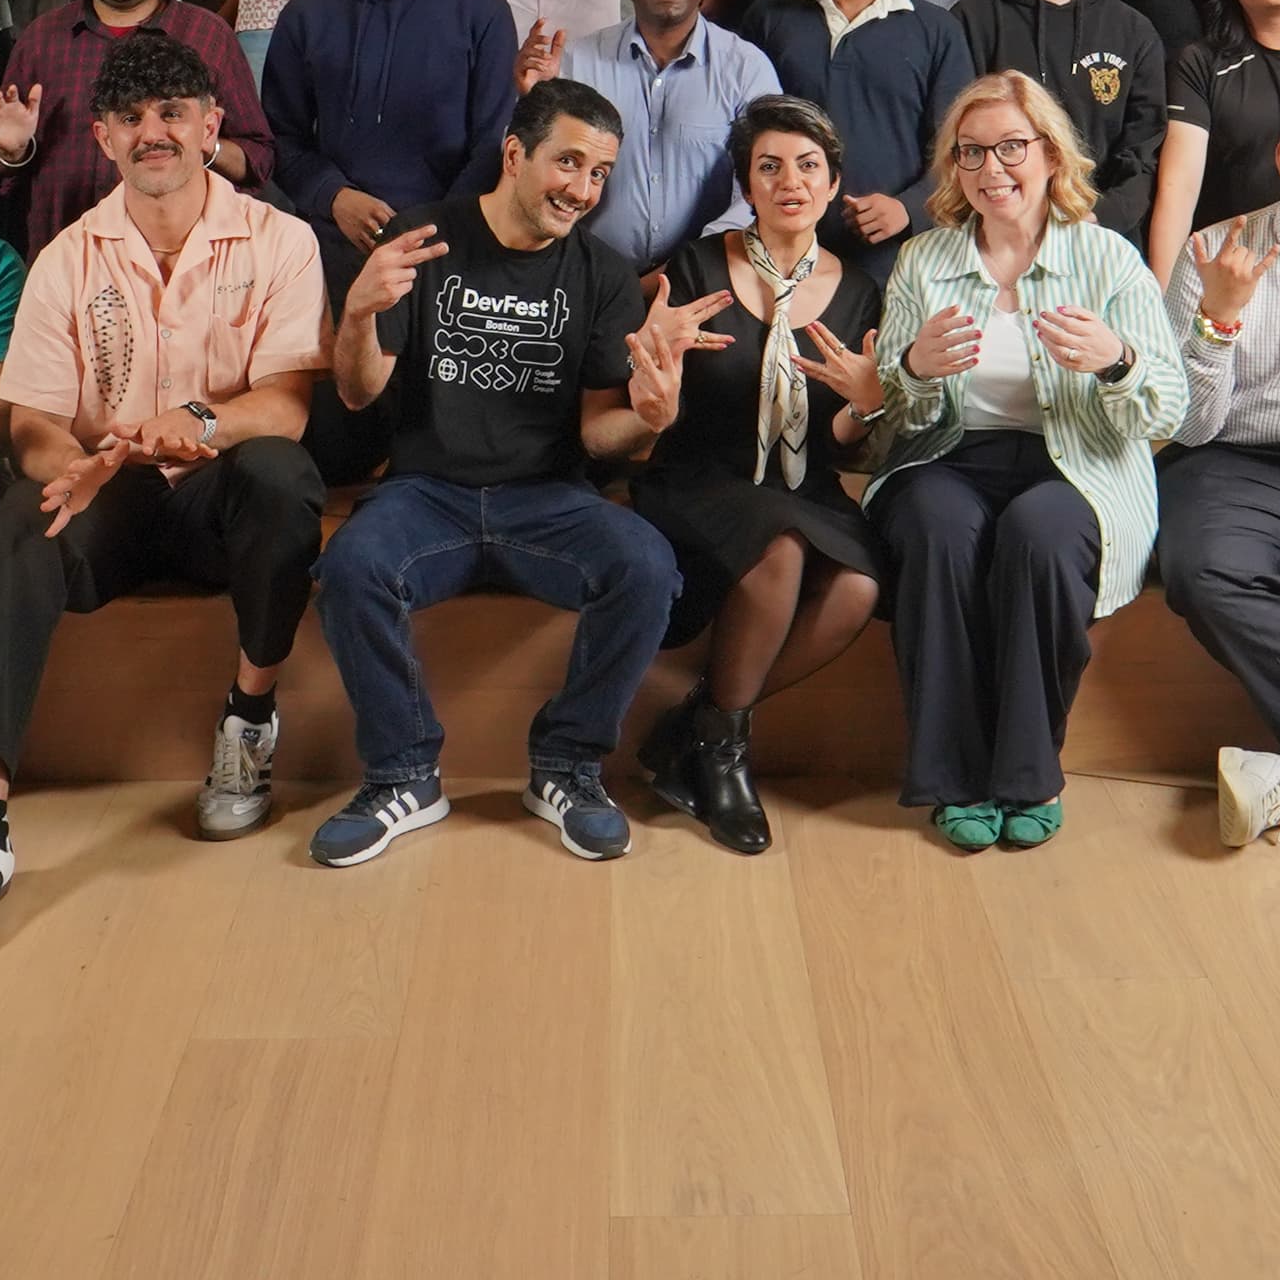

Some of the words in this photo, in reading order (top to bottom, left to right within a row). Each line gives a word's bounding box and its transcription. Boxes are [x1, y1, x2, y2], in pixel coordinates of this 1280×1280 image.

[1080, 52, 1100, 69] NEW
[1103, 52, 1128, 70] YORK
[462, 288, 549, 317] DevFest
[485, 319, 520, 332] Boston
